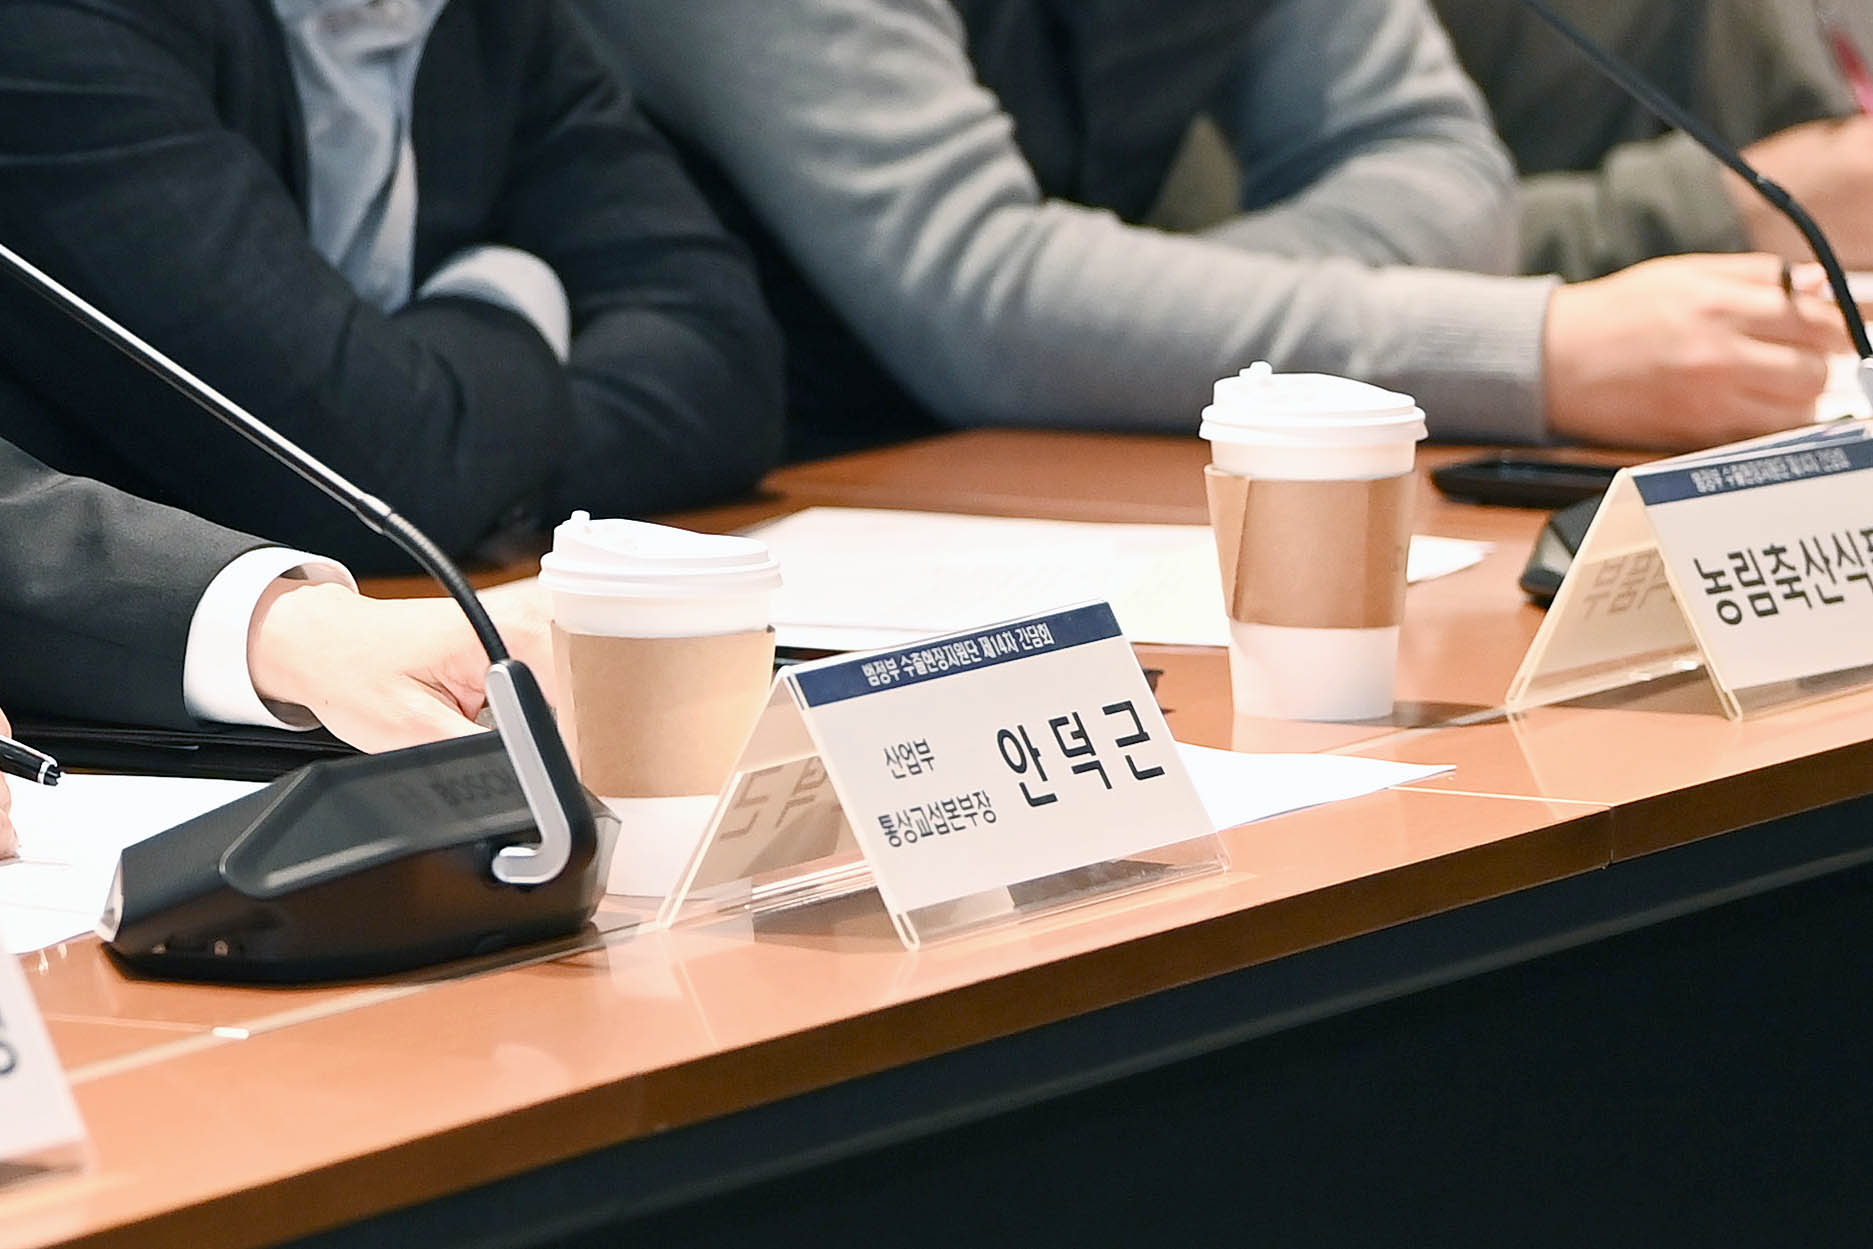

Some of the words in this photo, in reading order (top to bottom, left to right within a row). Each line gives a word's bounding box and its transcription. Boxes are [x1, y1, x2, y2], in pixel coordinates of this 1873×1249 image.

[861, 660, 901, 688] 범정부
[899, 642, 982, 678] 수출현장지원단
[980, 633, 1019, 661] 제14차
[1016, 621, 1055, 652] 간담회
[883, 738, 936, 780] 산업부
[997, 700, 1166, 808] 안덕근
[878, 789, 998, 848] 통상교섭본부장
